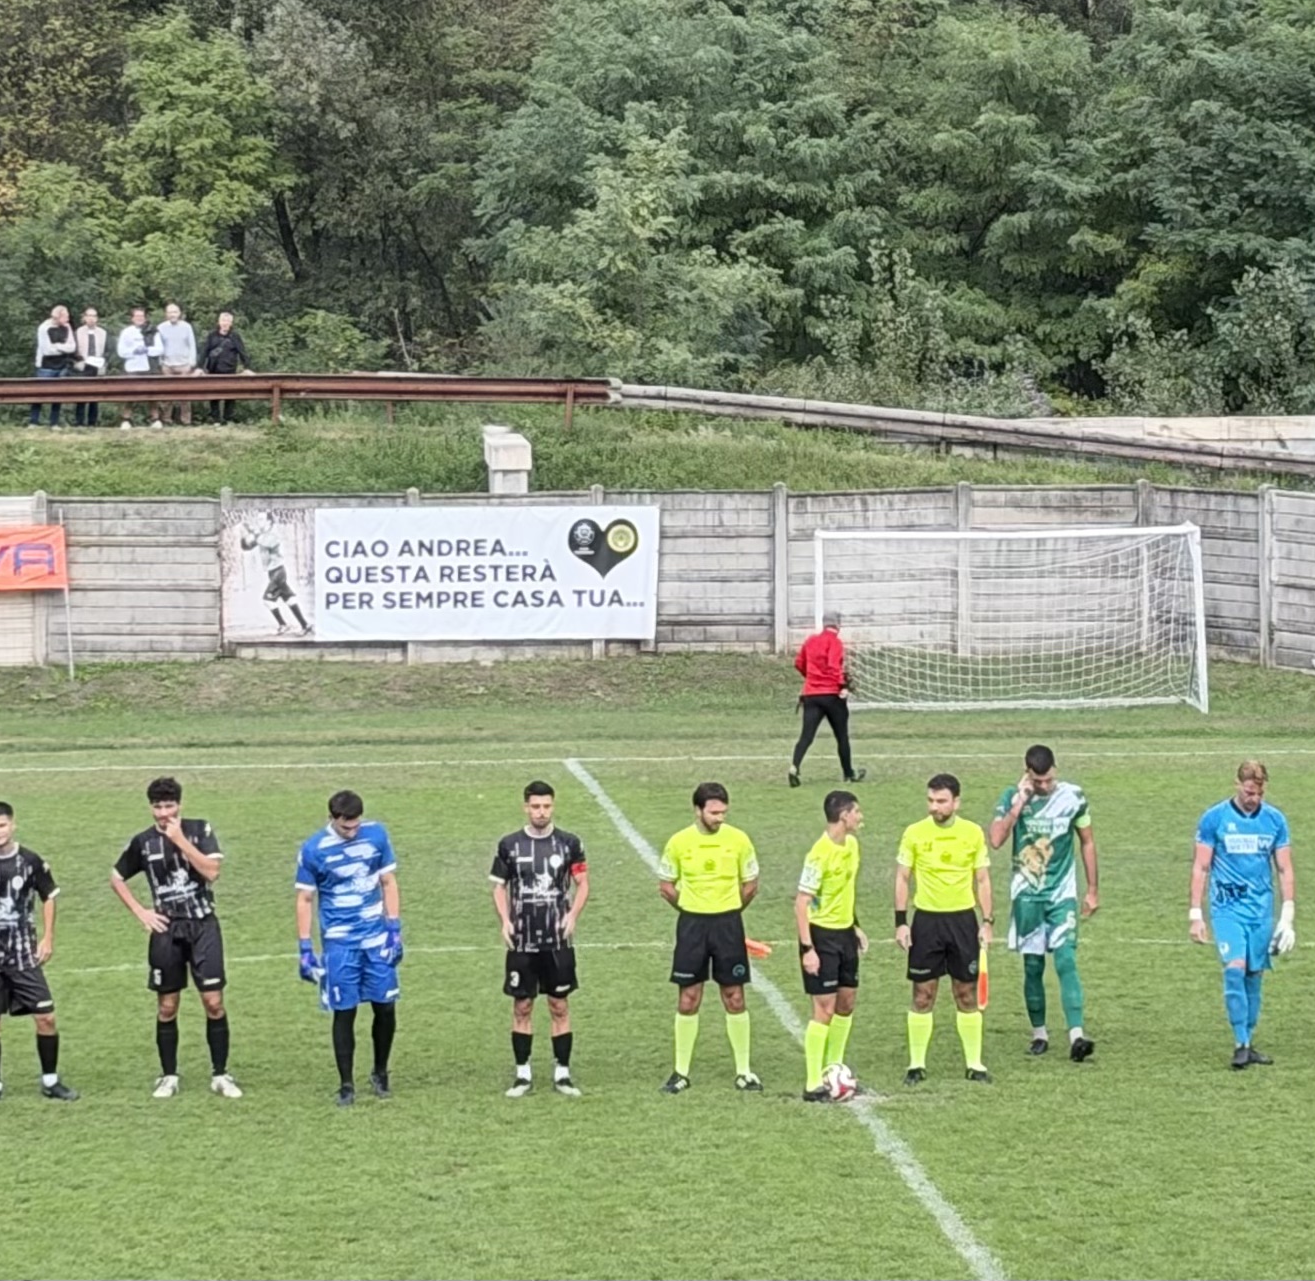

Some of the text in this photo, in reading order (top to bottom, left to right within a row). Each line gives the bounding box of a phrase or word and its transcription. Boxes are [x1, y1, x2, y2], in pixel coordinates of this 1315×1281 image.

[325, 538, 528, 558] CIAO ANDREA...
[325, 559, 557, 584] QUESTA RESTERÀ
[325, 589, 645, 610] PER SEMPRE CASA TUA...
[509, 971, 520, 987] 3
